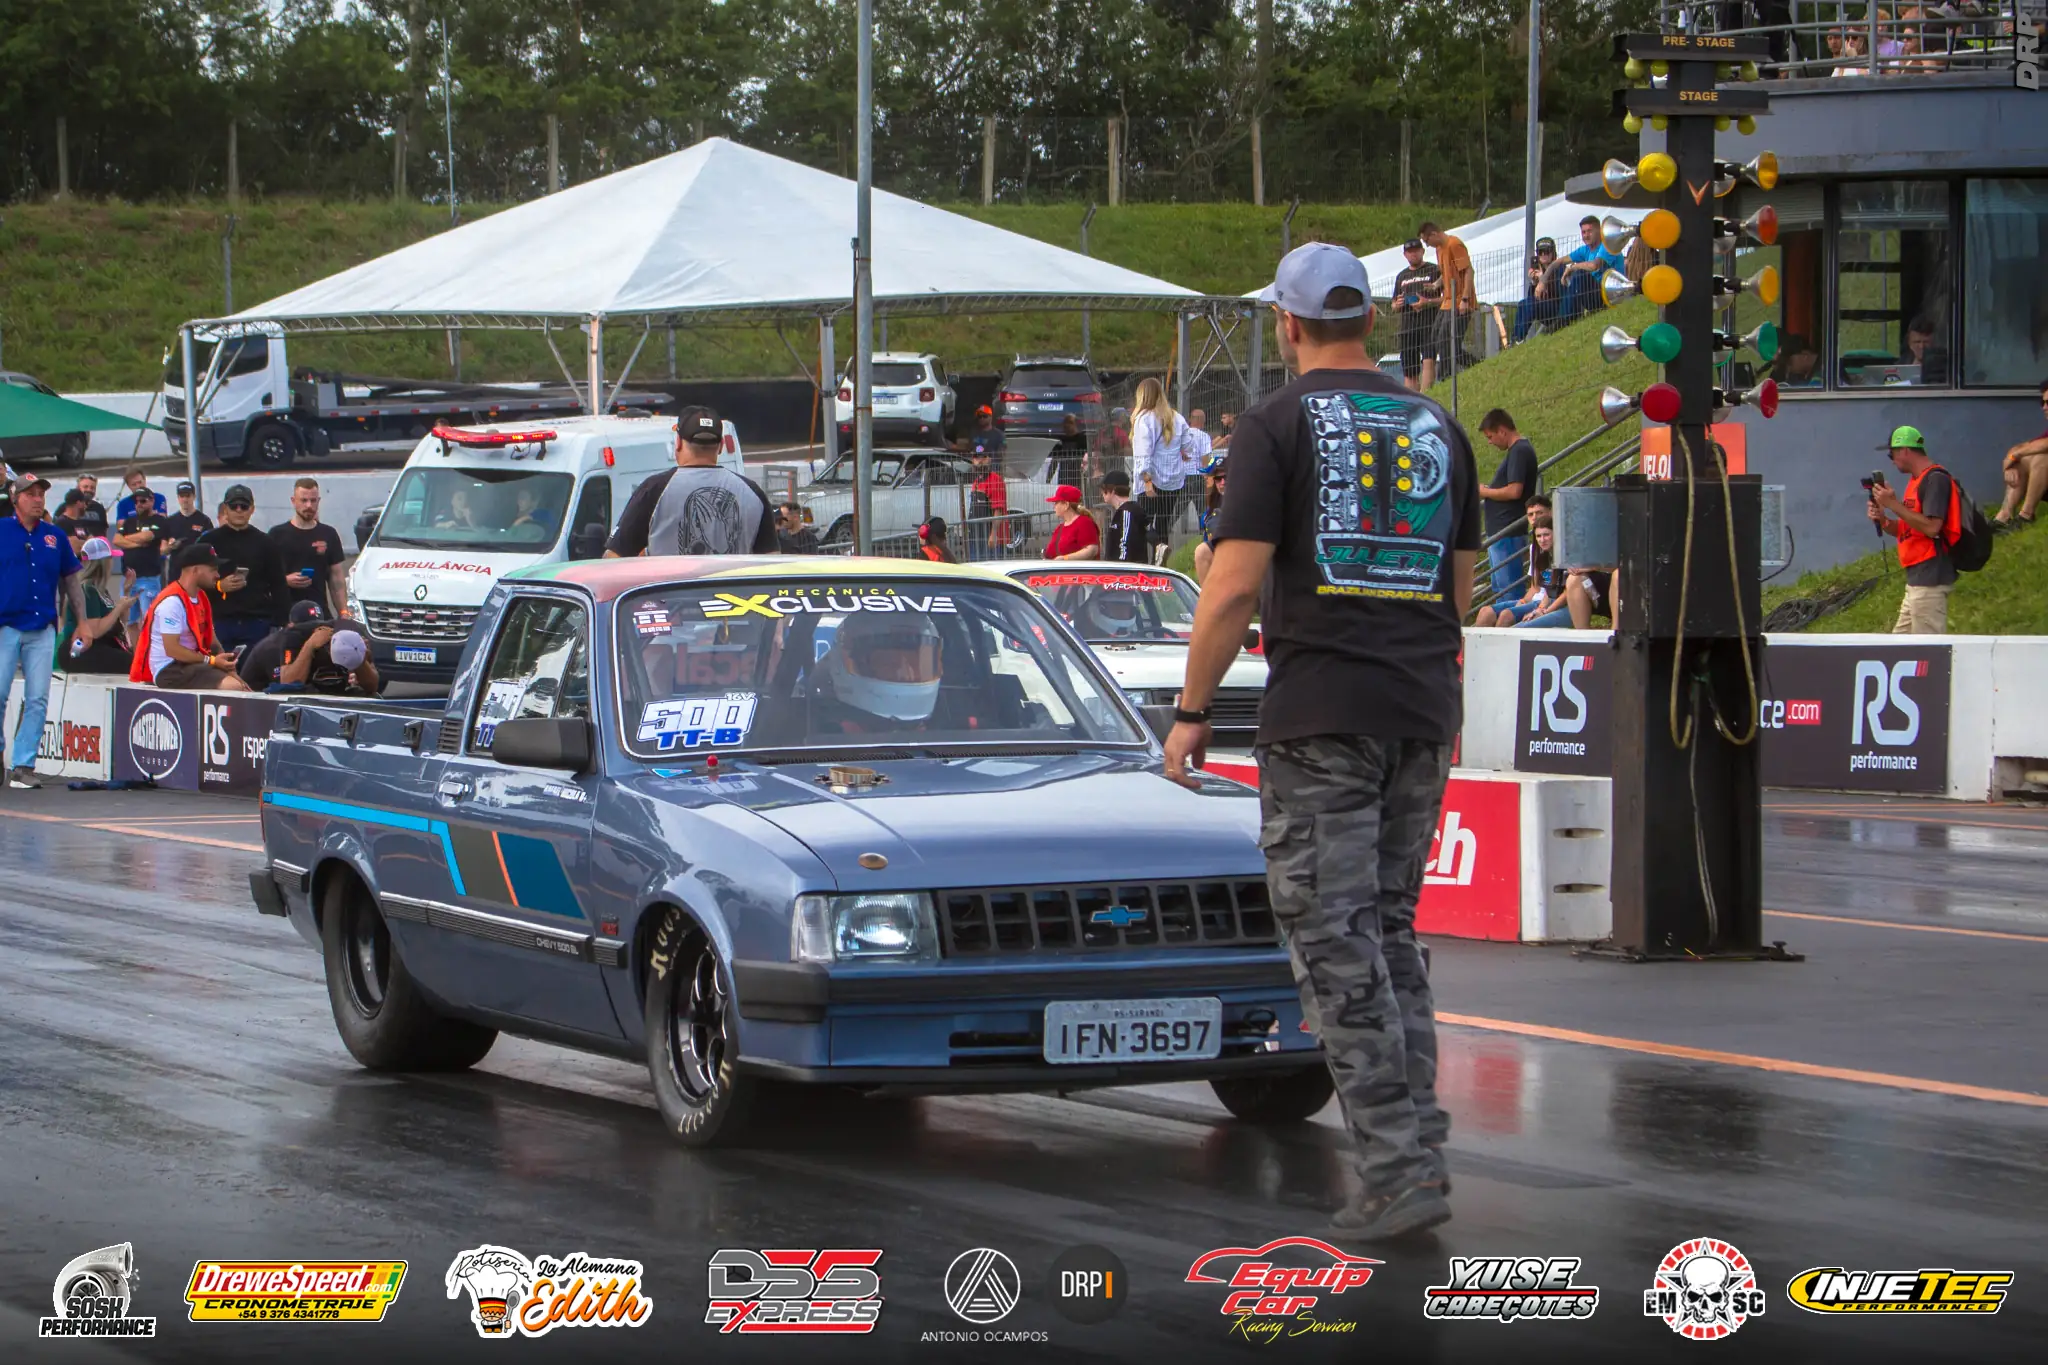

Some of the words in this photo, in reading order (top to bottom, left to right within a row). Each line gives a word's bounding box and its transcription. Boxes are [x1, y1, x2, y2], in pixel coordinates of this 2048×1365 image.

[1696, 37, 1736, 47] STAGE
[1679, 91, 1718, 101] STAGE
[1315, 546, 1440, 570] JULIETA
[778, 587, 896, 596] MECÂNICA
[1377, 589, 1414, 600] DRAG
[699, 593, 957, 617] EXCLUSIVE
[1531, 655, 1594, 733] RS
[1852, 660, 1928, 745] RS
[637, 699, 757, 741] 500
[204, 704, 231, 765] RS
[1529, 737, 1585, 756] performance
[1850, 751, 1917, 772] performance
[204, 768, 229, 782] performance
